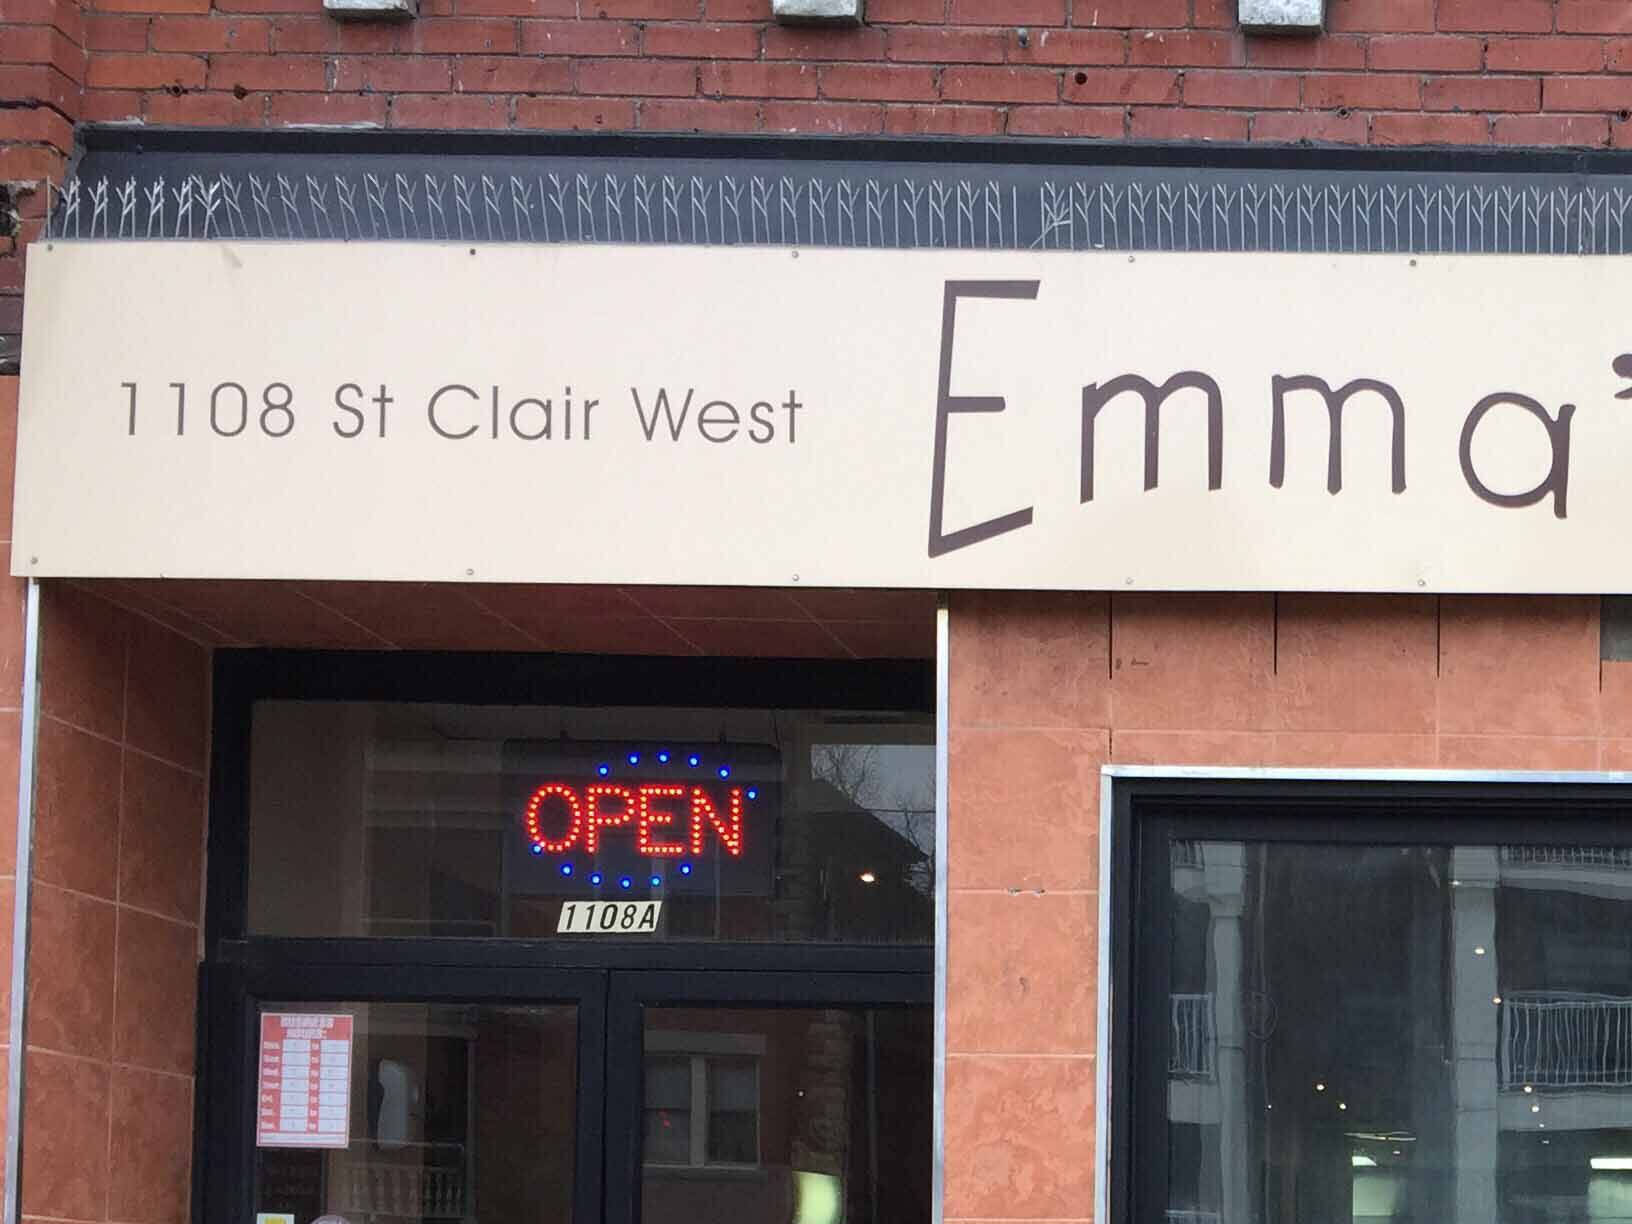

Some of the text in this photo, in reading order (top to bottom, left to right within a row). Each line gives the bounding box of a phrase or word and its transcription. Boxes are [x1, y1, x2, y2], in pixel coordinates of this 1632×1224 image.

[121, 381, 803, 444] 1108 St Clair West
[525, 783, 743, 856] OPEN
[565, 903, 656, 931] 1108A
